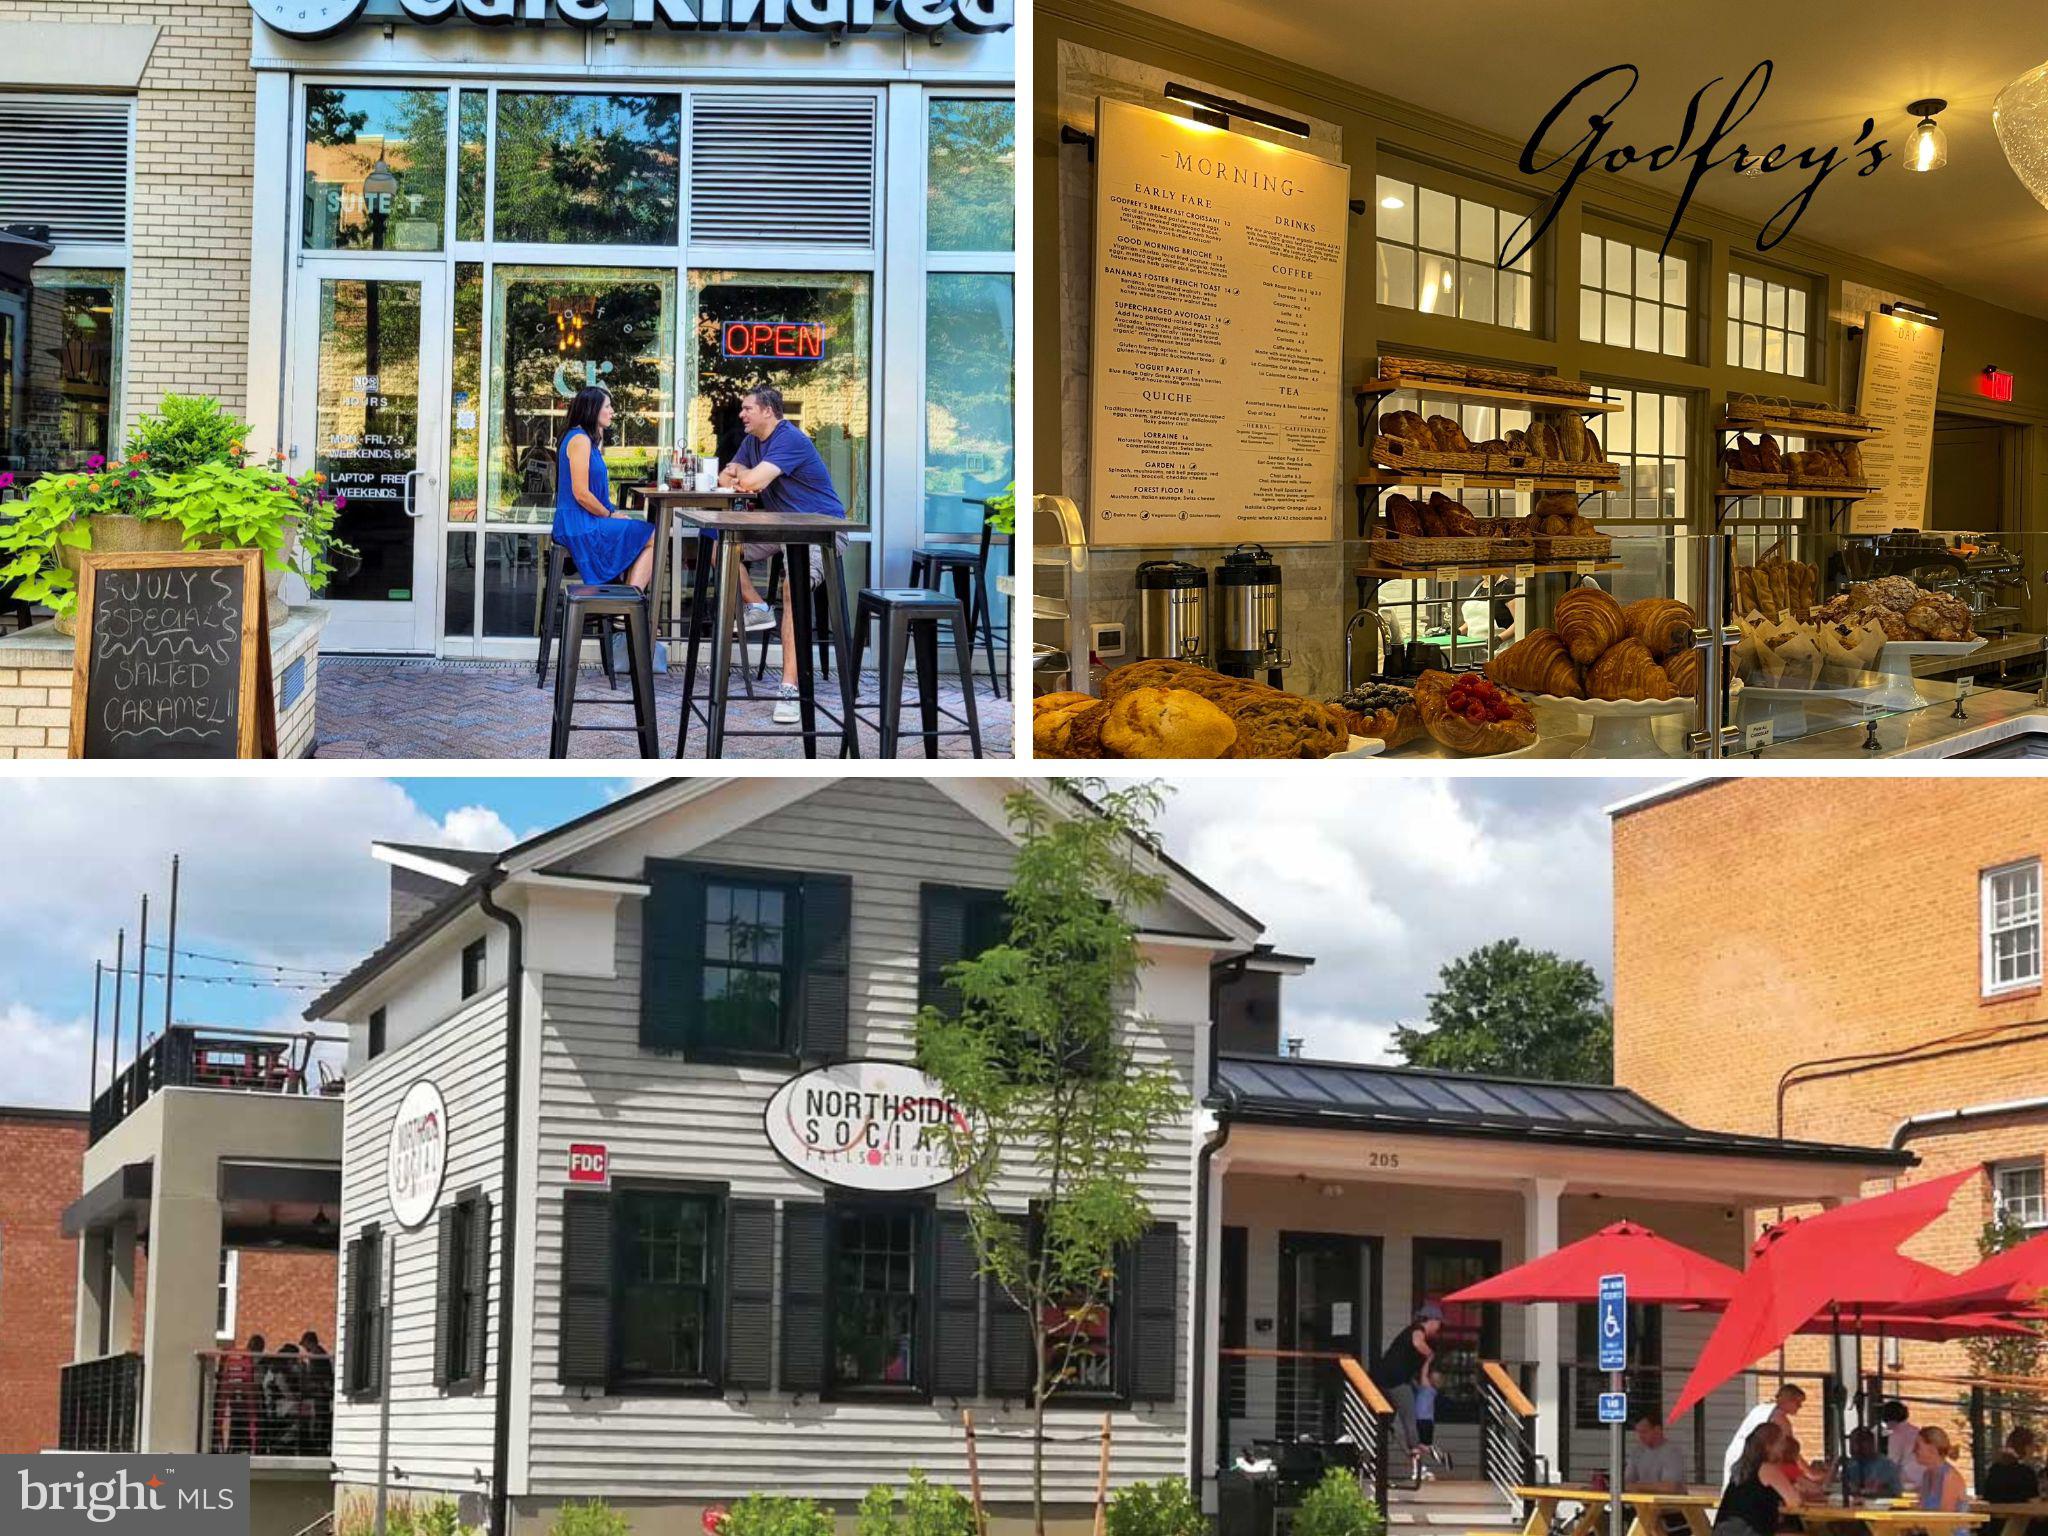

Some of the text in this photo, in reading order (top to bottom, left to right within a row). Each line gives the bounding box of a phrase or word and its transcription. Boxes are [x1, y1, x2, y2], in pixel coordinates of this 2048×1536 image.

[327, 191, 391, 213] SUITE
[1135, 184, 1212, 209] EARLY FARE
[1150, 204, 1185, 216] BREAKFAST
[1186, 212, 1220, 224] CROISSANT
[1275, 216, 1316, 233] DRINKS
[1117, 236, 1142, 246] GOOD
[1144, 241, 1180, 253] MORNING
[1182, 248, 1212, 259] BRIOCHE
[1105, 267, 1142, 279] BANANAS
[1144, 274, 1169, 283] FOSTER
[1172, 278, 1198, 288] FRENCH
[1200, 283, 1221, 292] TOAST
[1272, 265, 1313, 280] COFFEE
[1115, 301, 1173, 316] SUPERCHARGED
[1174, 311, 1211, 322] AVOTOAST
[726, 325, 824, 357] OPEN
[1135, 362, 1164, 371] YOGURT
[1166, 366, 1194, 375] PARFAIT
[1142, 390, 1192, 403] QUICHE
[1279, 387, 1299, 396] TEA
[1144, 432, 1178, 440] LORRAINE
[330, 472, 407, 485] LAPTOP FREE
[336, 487, 397, 498] WEEKENDS
[121, 571, 198, 605] JULY
[108, 606, 221, 638] SPECIAL
[114, 659, 210, 691] SALTED
[806, 1088, 959, 1125] NORTHSIDE
[805, 1118, 932, 1152] SOCIA
[571, 1154, 604, 1172] FDC
[1369, 1152, 1399, 1168] 205
